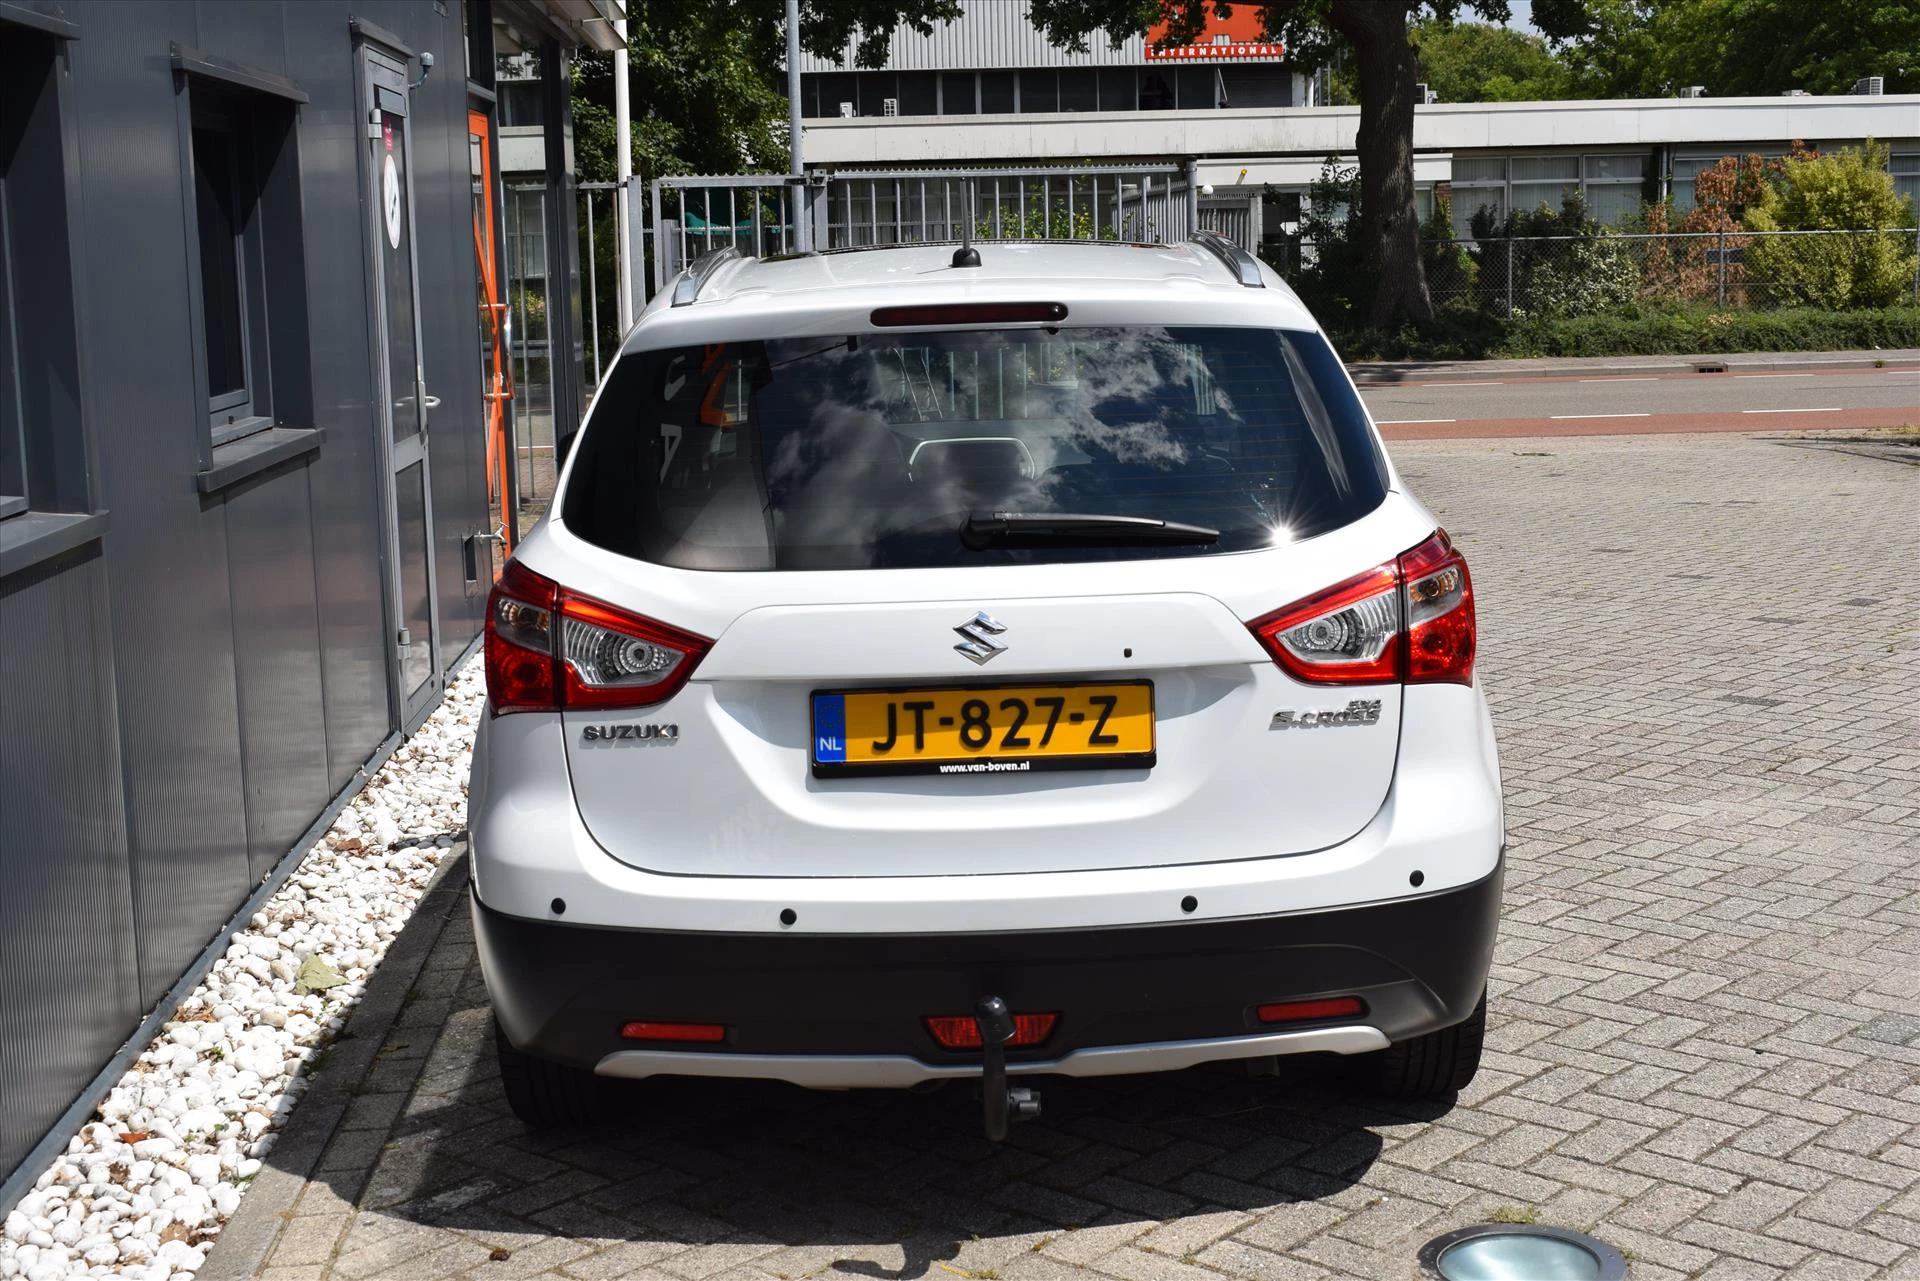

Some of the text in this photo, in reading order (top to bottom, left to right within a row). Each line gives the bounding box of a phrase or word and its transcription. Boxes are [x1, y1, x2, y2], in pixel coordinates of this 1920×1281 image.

[1151, 47, 1277, 57] INTERNATIONAL
[872, 695, 1119, 752] JT-827-Z
[583, 723, 679, 741] SUZUKI
[820, 737, 842, 751] NL
[940, 761, 1030, 773] www.van-boven.nl
